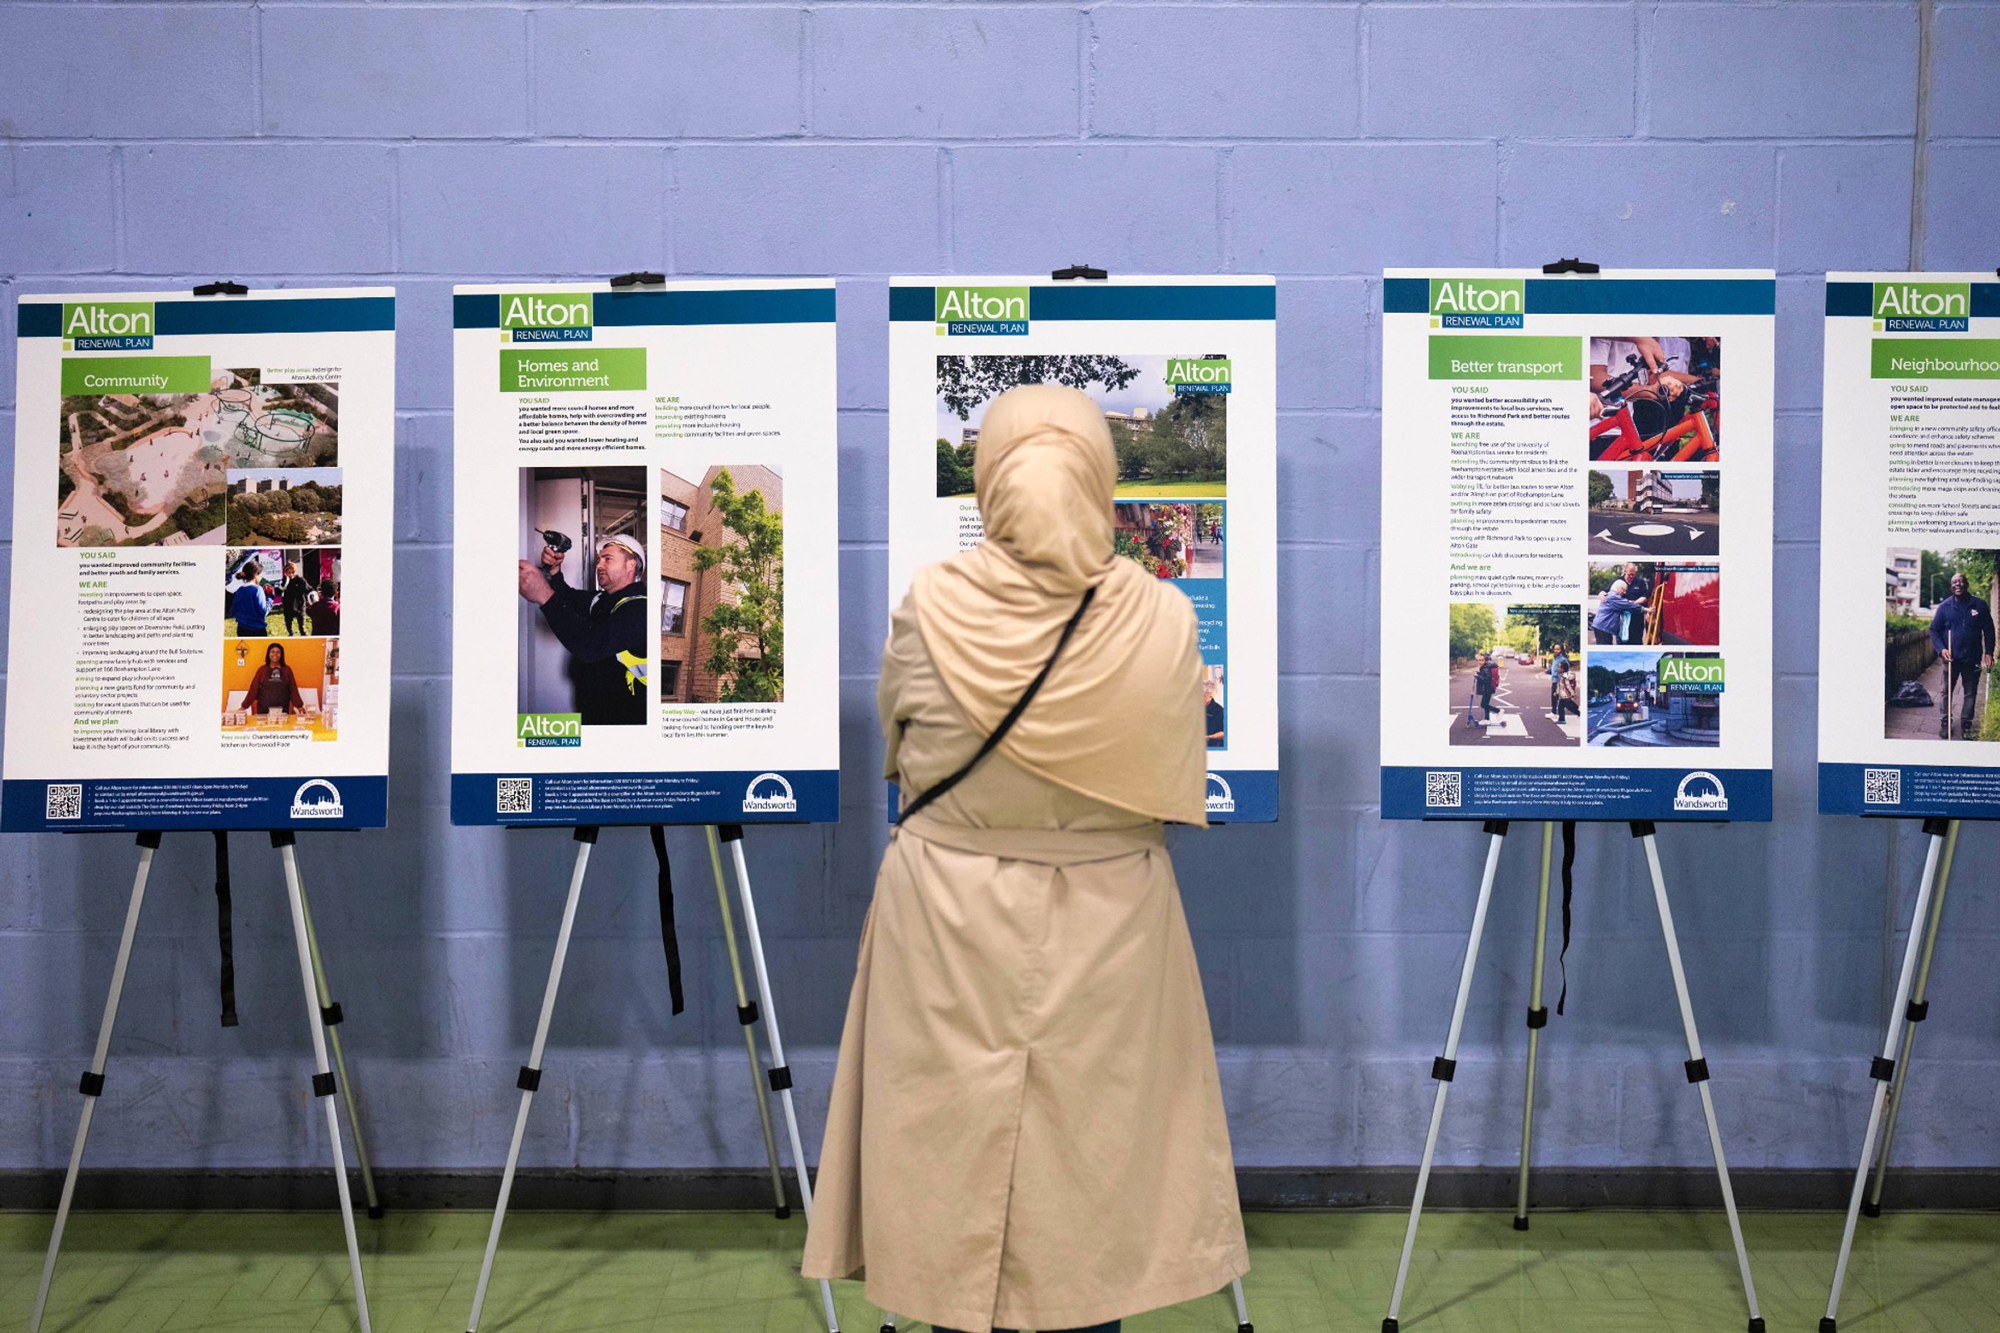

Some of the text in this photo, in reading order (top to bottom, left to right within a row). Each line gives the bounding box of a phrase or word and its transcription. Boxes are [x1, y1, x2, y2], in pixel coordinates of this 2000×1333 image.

[1434, 282, 1520, 312] Alton
[1877, 286, 1965, 315] Alton
[940, 290, 1025, 319] Alton
[505, 297, 589, 325] Alton
[67, 305, 151, 335] Alton
[1445, 316, 1520, 326] RENEWAL PLAN
[1889, 320, 1965, 329] RENEWAL PLAN
[952, 323, 1025, 334] RENEWAL PLAN
[516, 330, 588, 340] RENEWAL PLAN
[78, 338, 150, 349] RENEWAL PLAN
[518, 359, 599, 372] Homes and
[1451, 360, 1563, 376] Better transport
[1891, 357, 2000, 373] Neighbourhoo
[1171, 362, 1229, 382] Alton
[84, 374, 169, 390] Community
[518, 374, 610, 388] Environment
[1178, 384, 1229, 393] RENEWAL PLAN
[570, 412, 582, 420] help
[597, 412, 635, 420] overcrowding
[600, 420, 620, 428] density
[1451, 420, 1475, 428] through
[605, 436, 627, 444] heating
[112, 561, 139, 569] improved
[109, 569, 126, 577] youth
[1662, 660, 1722, 681] Alton
[102, 718, 119, 726] plan
[520, 715, 579, 736] Alton
[528, 738, 579, 747] RENEWAL PLAN
[744, 800, 796, 810] Wandsworth
[1206, 800, 1234, 810] sworth
[1674, 799, 1727, 809] Wandsworth
[291, 806, 343, 817] Wandsworth
